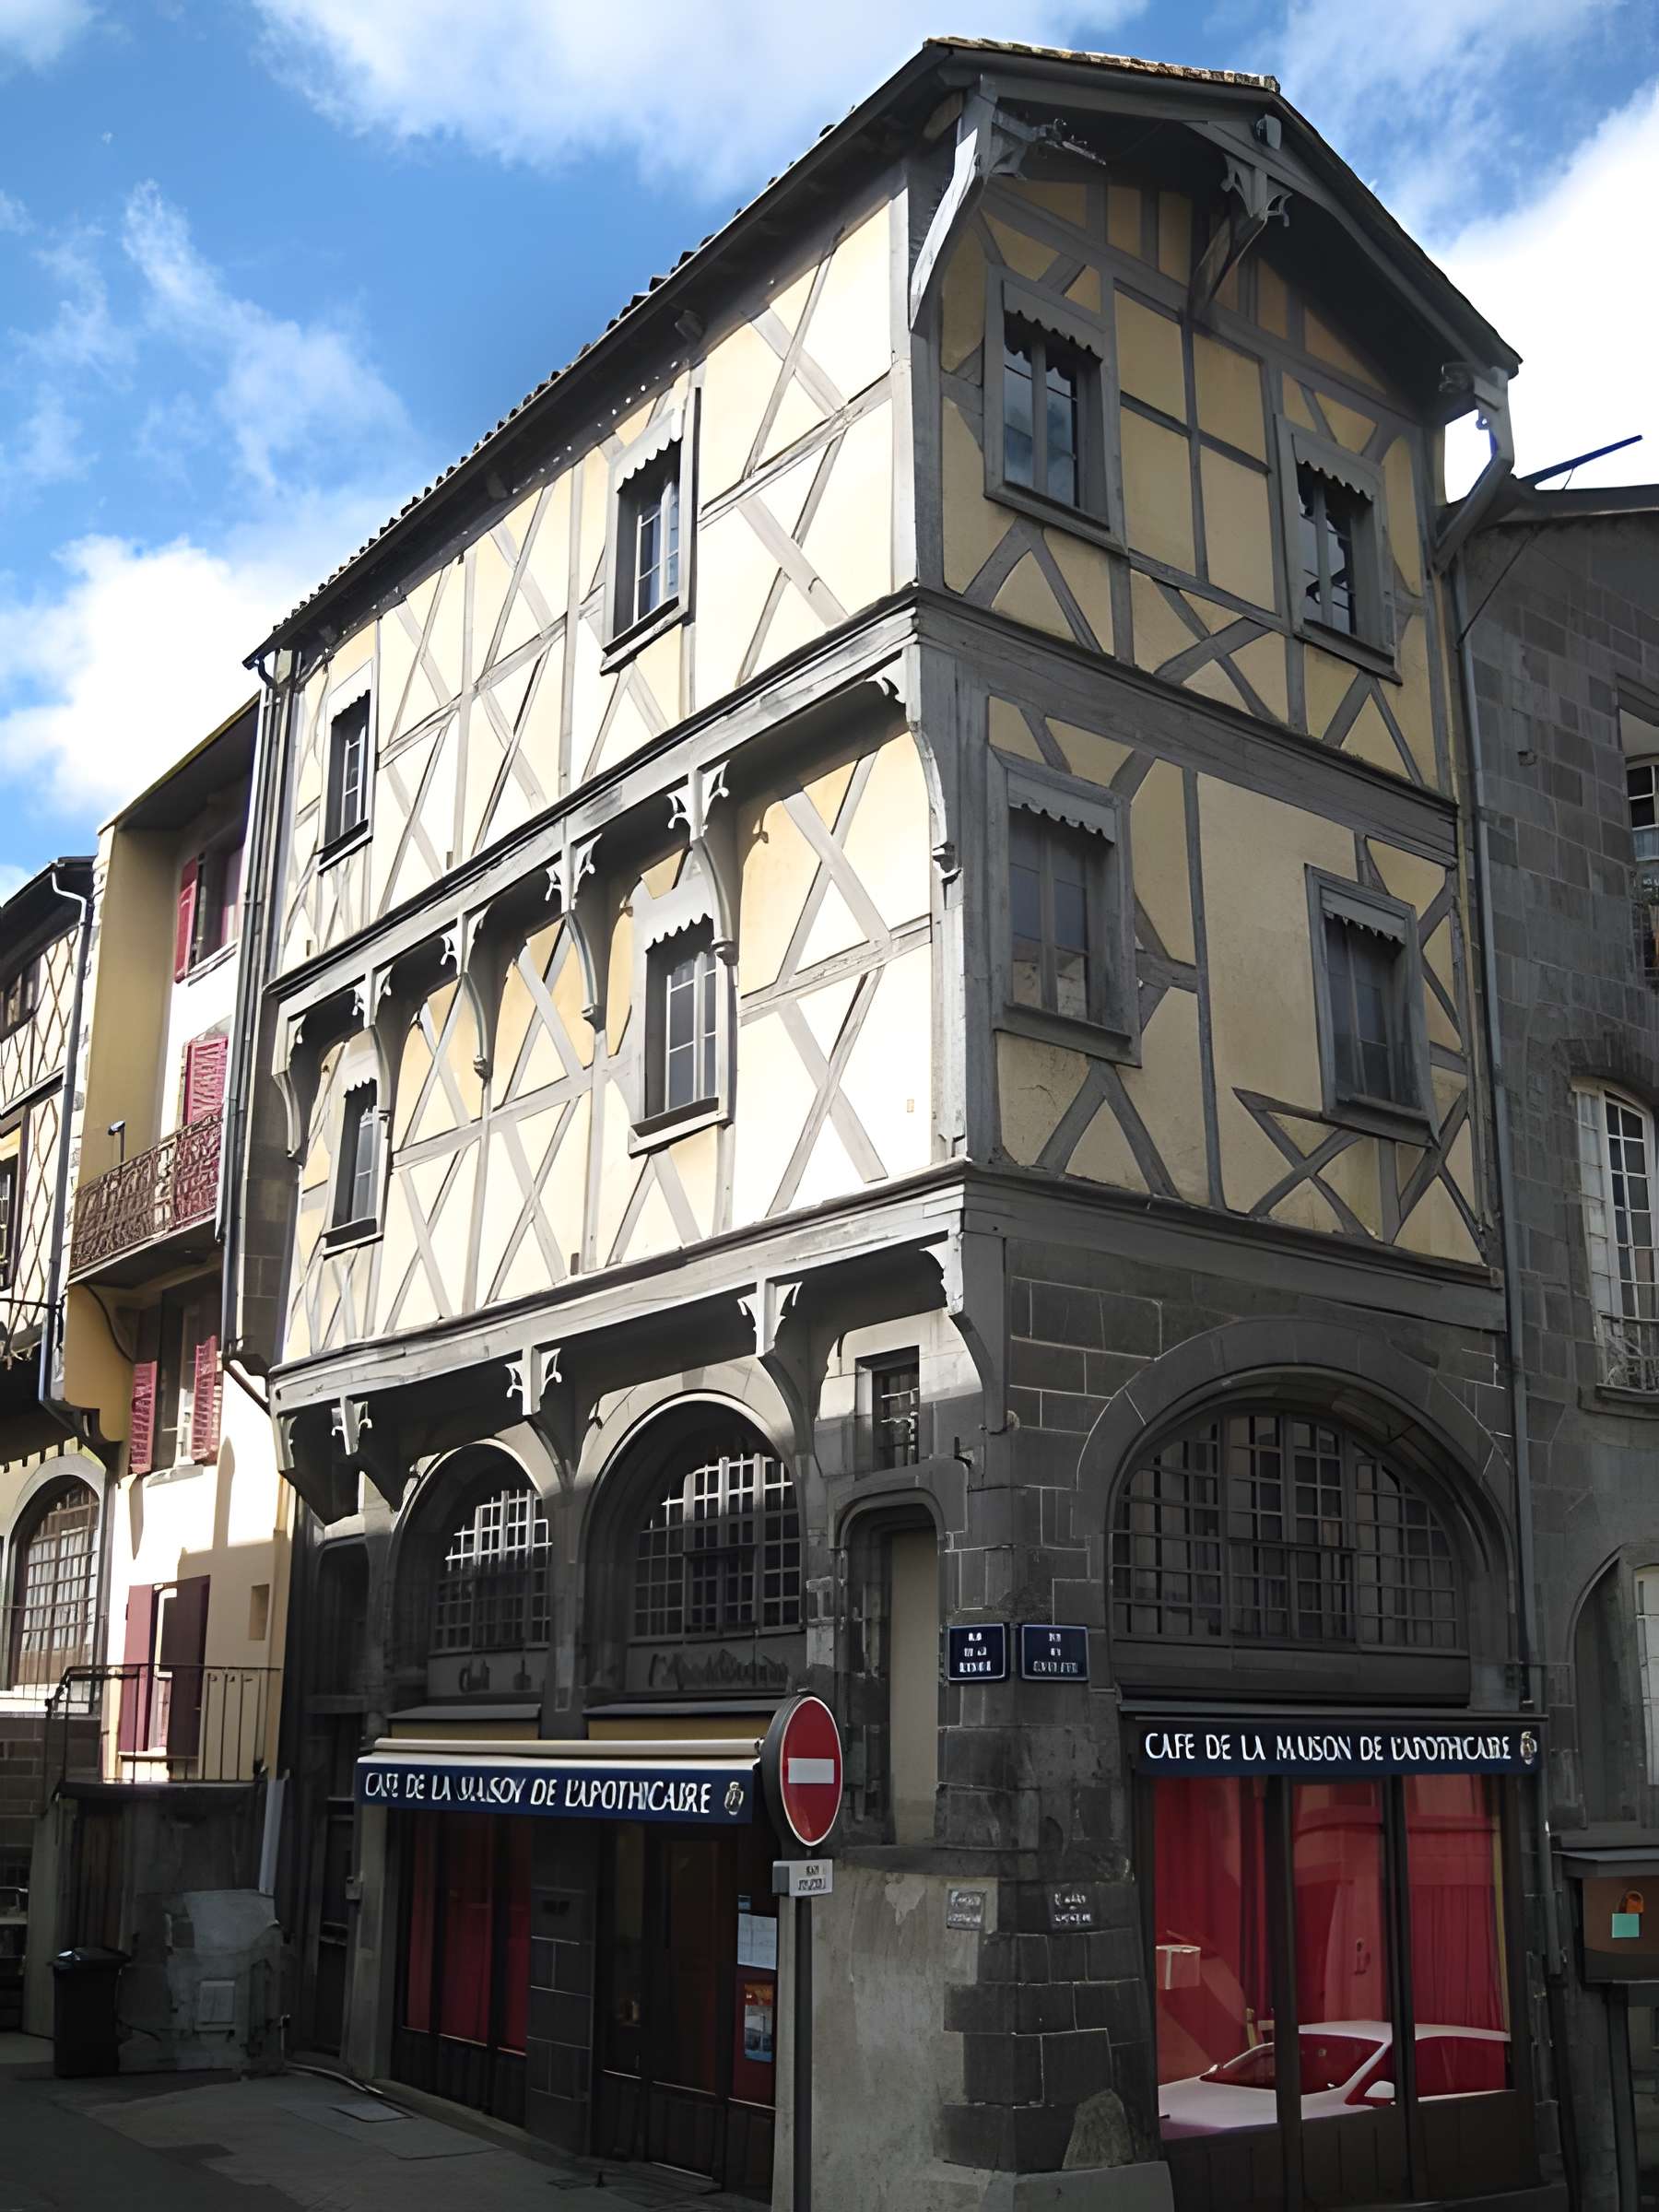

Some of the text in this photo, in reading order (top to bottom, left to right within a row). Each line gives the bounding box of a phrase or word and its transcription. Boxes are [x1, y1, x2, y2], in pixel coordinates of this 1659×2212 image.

[1145, 1733, 1194, 1759] CAFE
[1206, 1734, 1231, 1759] DE
[1241, 1735, 1267, 1760] LA
[1277, 1735, 1352, 1760] MAISON
[1360, 1736, 1382, 1760] DE
[406, 1773, 425, 1799] DE
[432, 1775, 451, 1801] LA
[531, 1778, 557, 1806] DE
[565, 1779, 712, 1813] L'APOTHICAIRE
